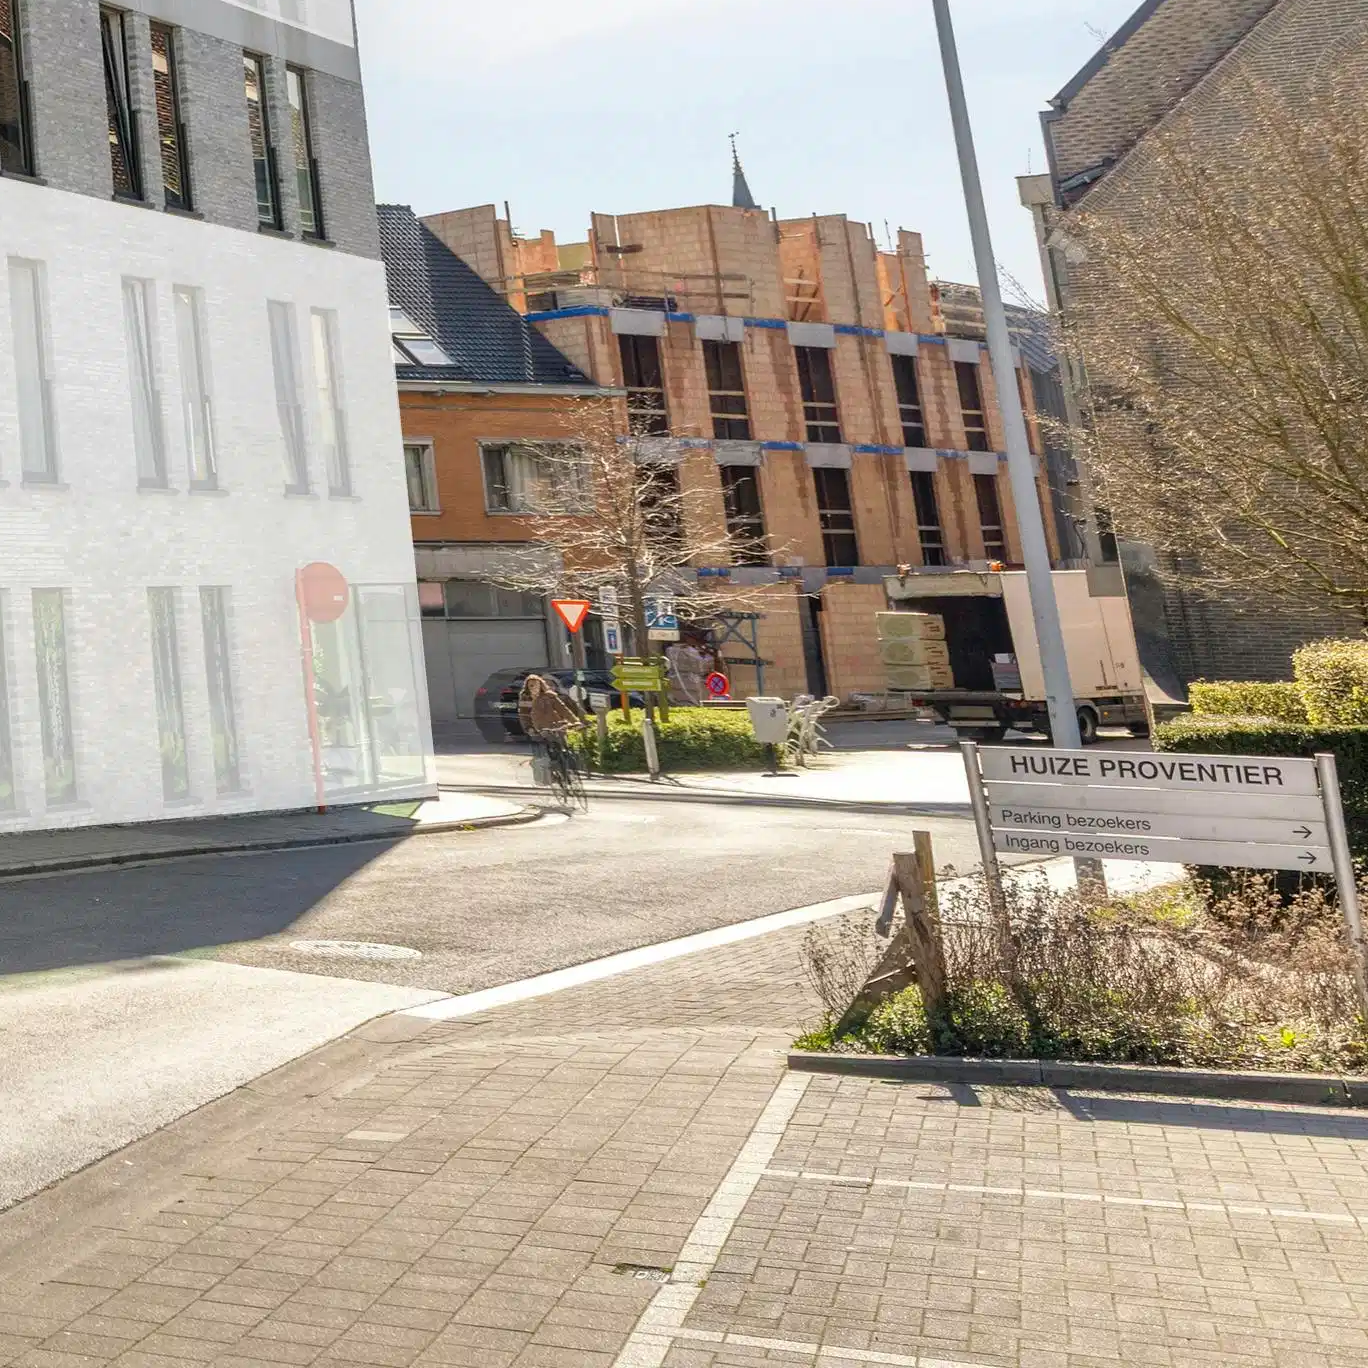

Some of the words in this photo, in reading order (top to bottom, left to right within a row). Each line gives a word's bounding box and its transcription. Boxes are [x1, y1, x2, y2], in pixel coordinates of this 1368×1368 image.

[1010, 755, 1091, 777] HUIZE
[1100, 759, 1284, 786] PROVENTIER
[1002, 809, 1061, 829] Parking
[1066, 813, 1151, 831] bezoekers
[1005, 835, 1060, 853] Ingang
[1065, 839, 1150, 856] bezoekers
